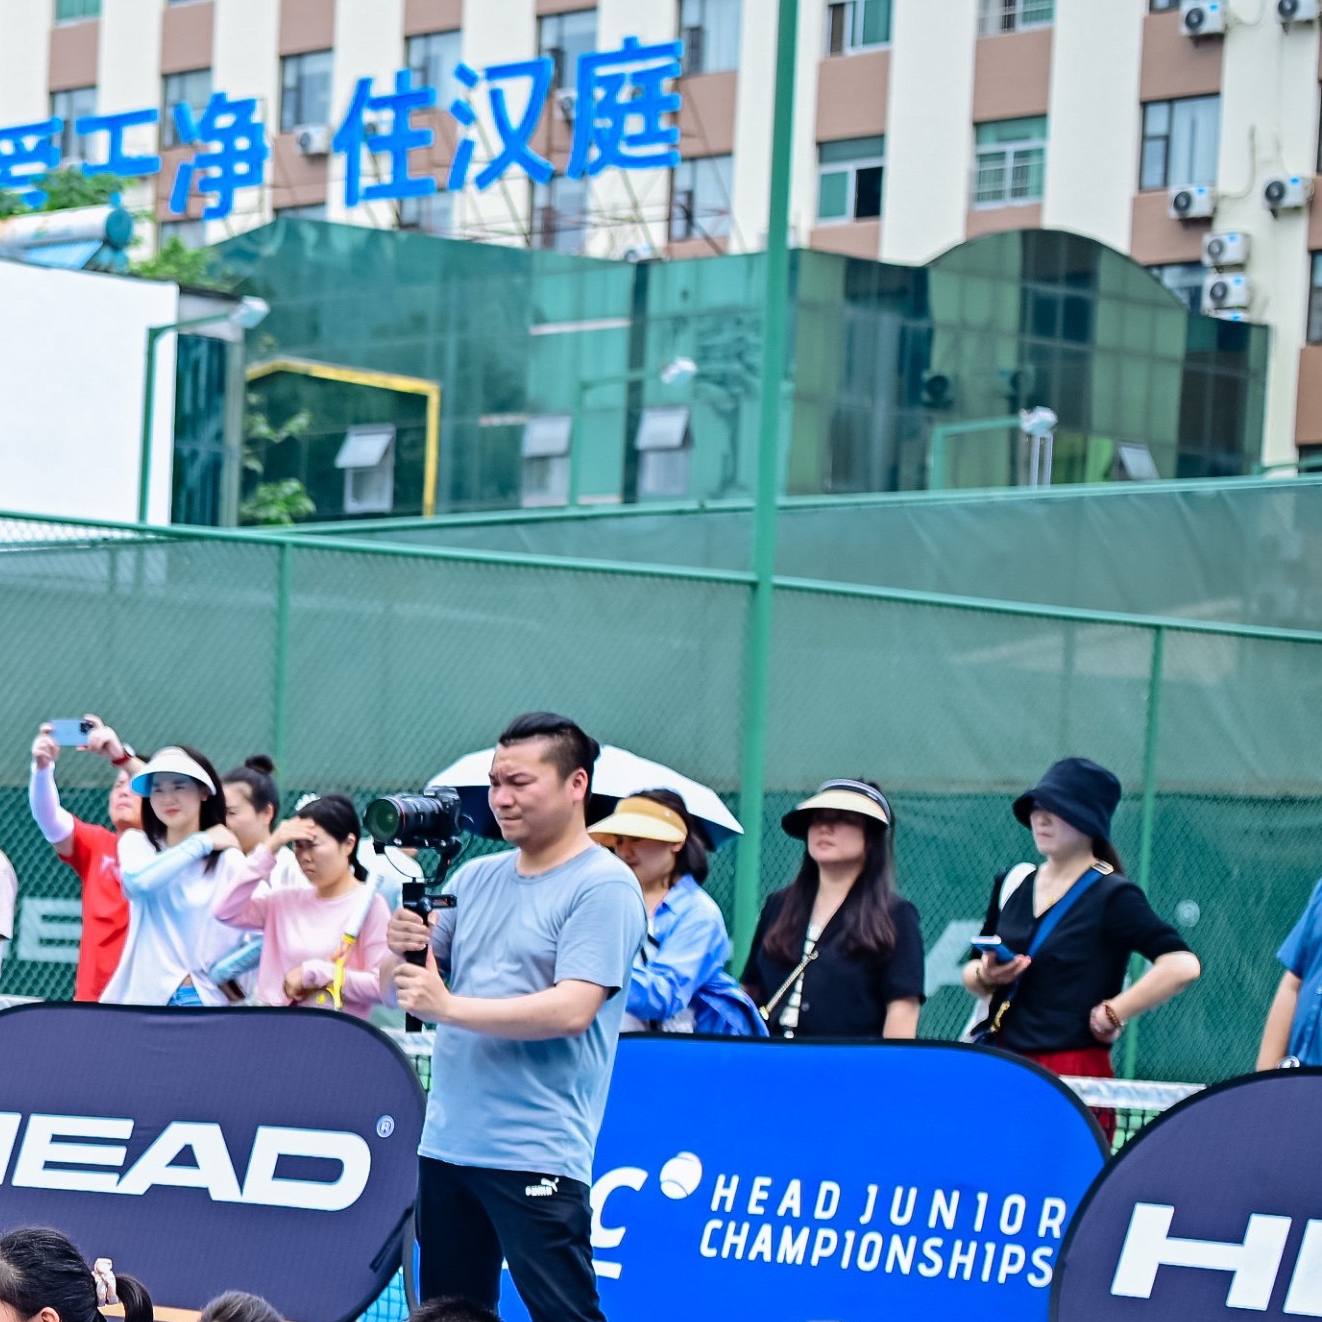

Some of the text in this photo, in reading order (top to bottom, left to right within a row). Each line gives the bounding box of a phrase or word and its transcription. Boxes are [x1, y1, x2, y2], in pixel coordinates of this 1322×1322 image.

[332, 35, 685, 208] 住汉庭
[700, 1218, 1054, 1289] CHAMPIONSHIPS
[710, 1174, 1068, 1240] HEAD JUNIOR
[1111, 1202, 1322, 1318] H
